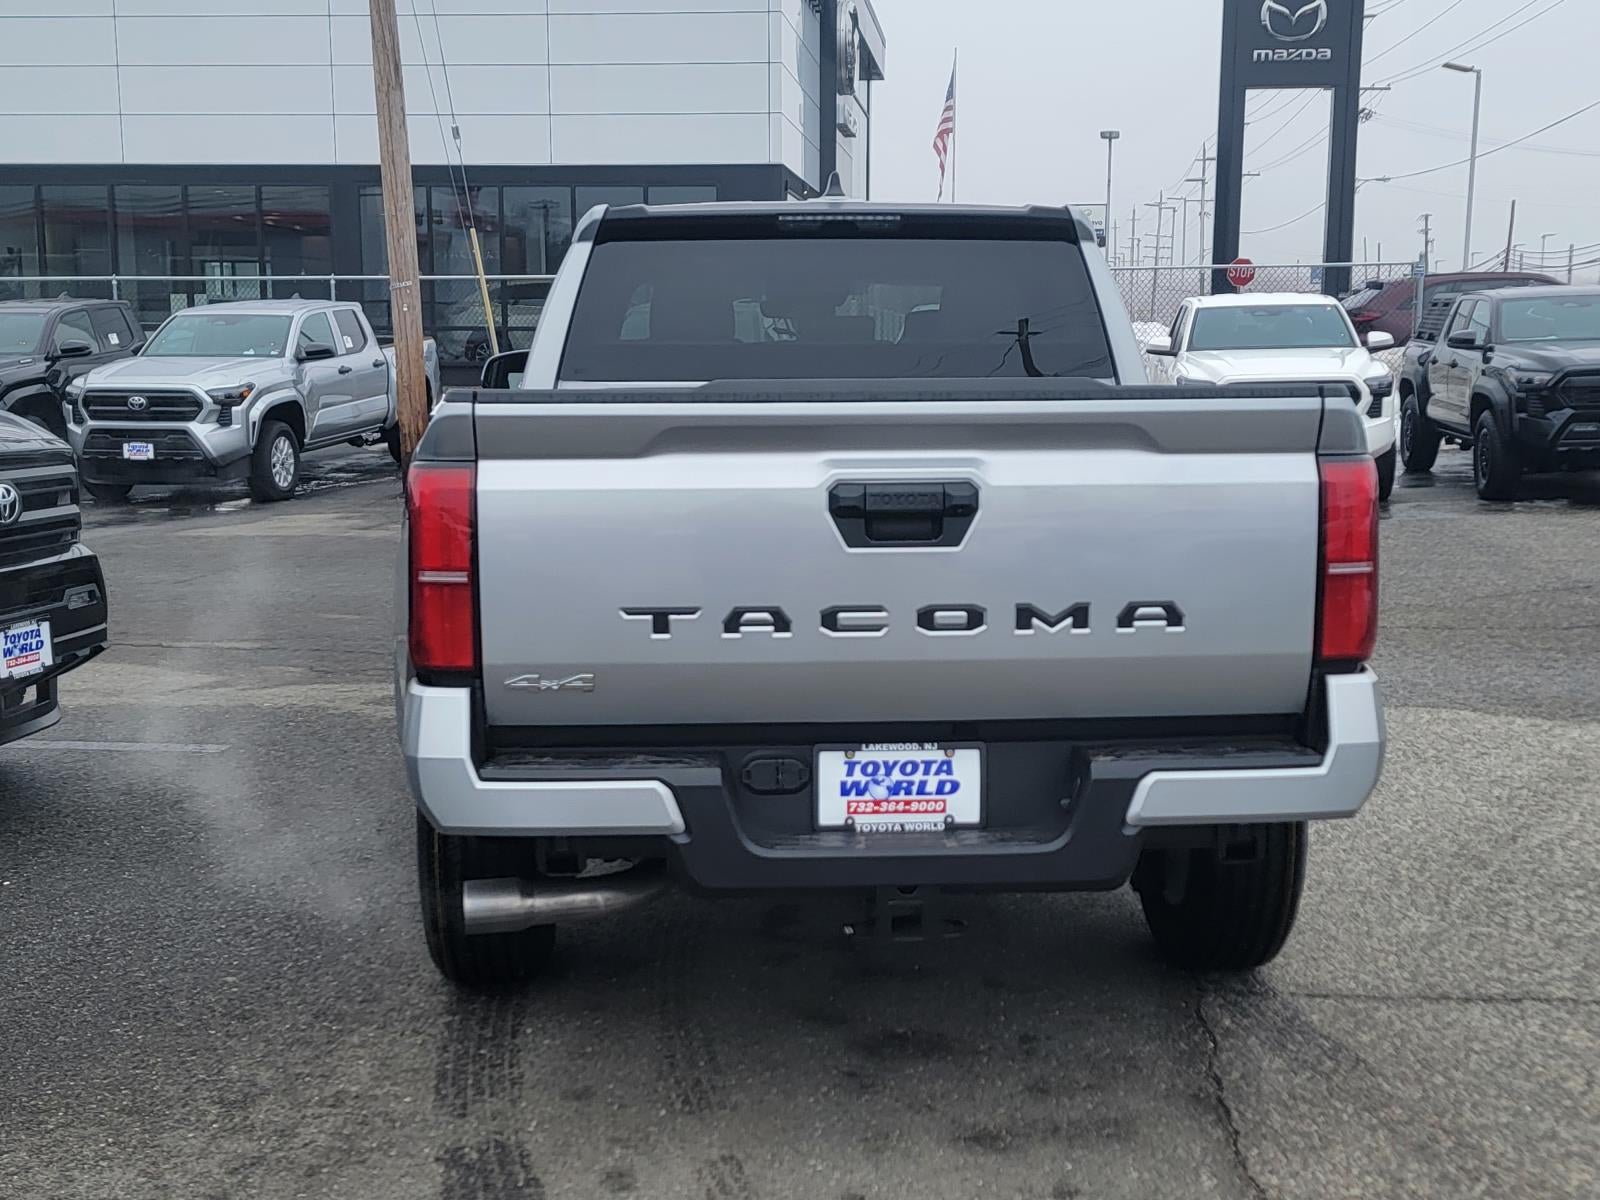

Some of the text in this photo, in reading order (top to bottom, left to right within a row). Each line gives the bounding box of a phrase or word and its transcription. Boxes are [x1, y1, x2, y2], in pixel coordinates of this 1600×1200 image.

[1252, 48, 1332, 62] mazda
[1229, 267, 1254, 278] STOP
[619, 600, 1186, 640] TACOMA
[4, 628, 41, 645] TOYOTA
[924, 742, 938, 750] NJ
[843, 759, 954, 777] TOYOTA
[849, 801, 945, 813] 732-364-9000
[856, 822, 946, 833] TOYOTA WORLD
